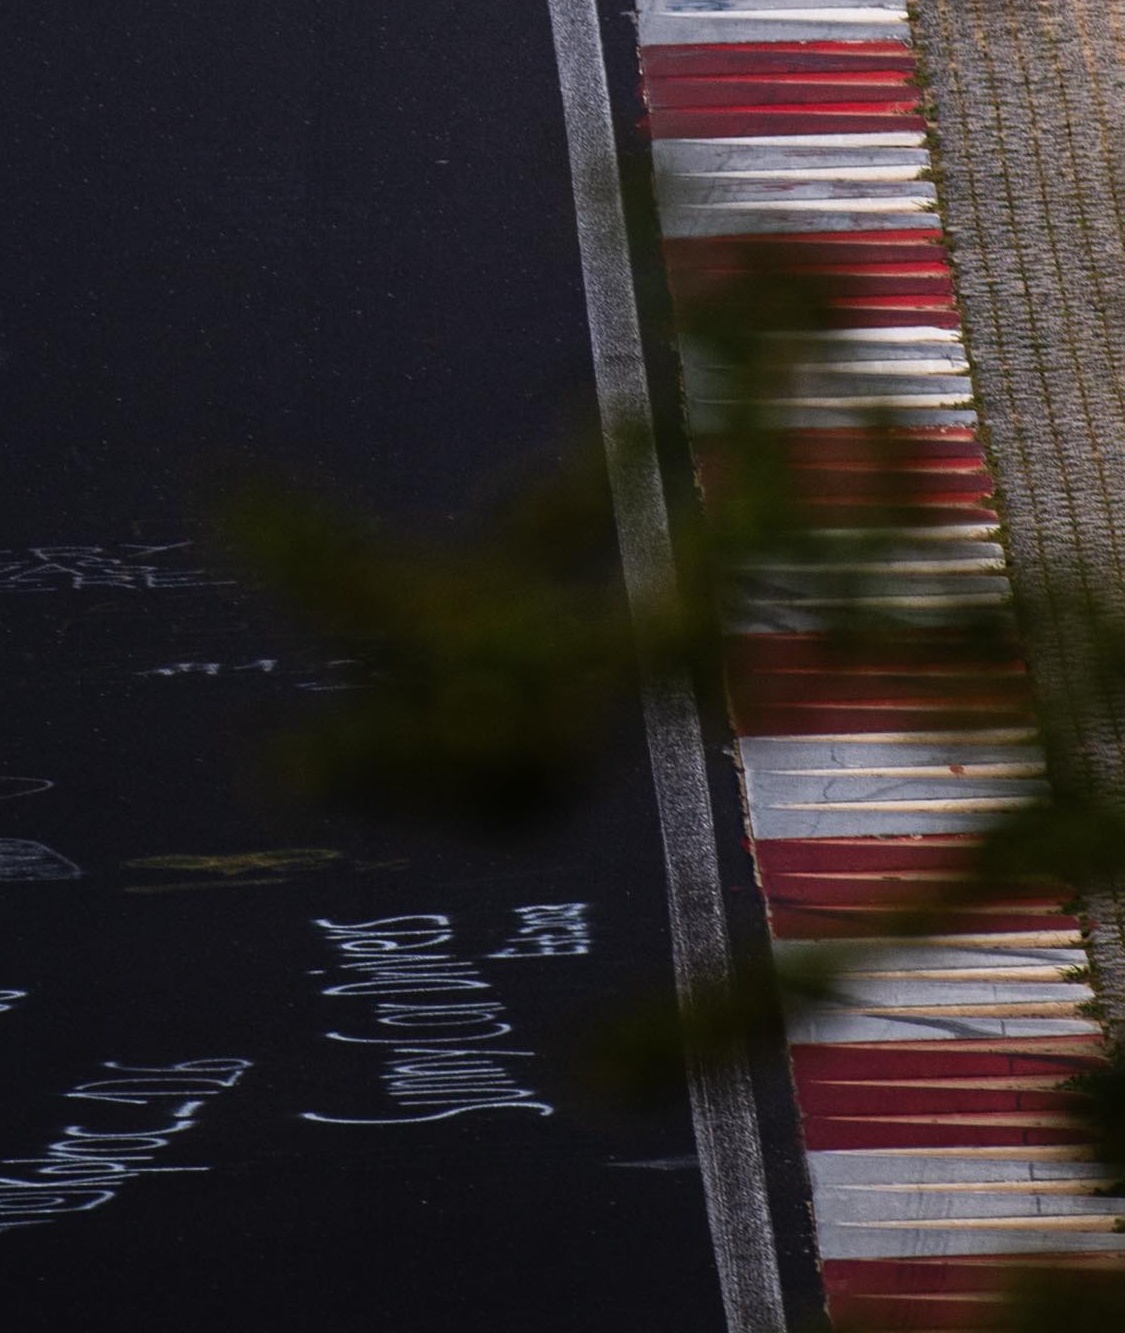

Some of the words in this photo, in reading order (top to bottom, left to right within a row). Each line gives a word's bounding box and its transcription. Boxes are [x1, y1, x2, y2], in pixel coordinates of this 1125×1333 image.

[307, 914, 493, 995] Drivers
[325, 1003, 513, 1043] Car
[301, 1049, 554, 1124] Sunny
